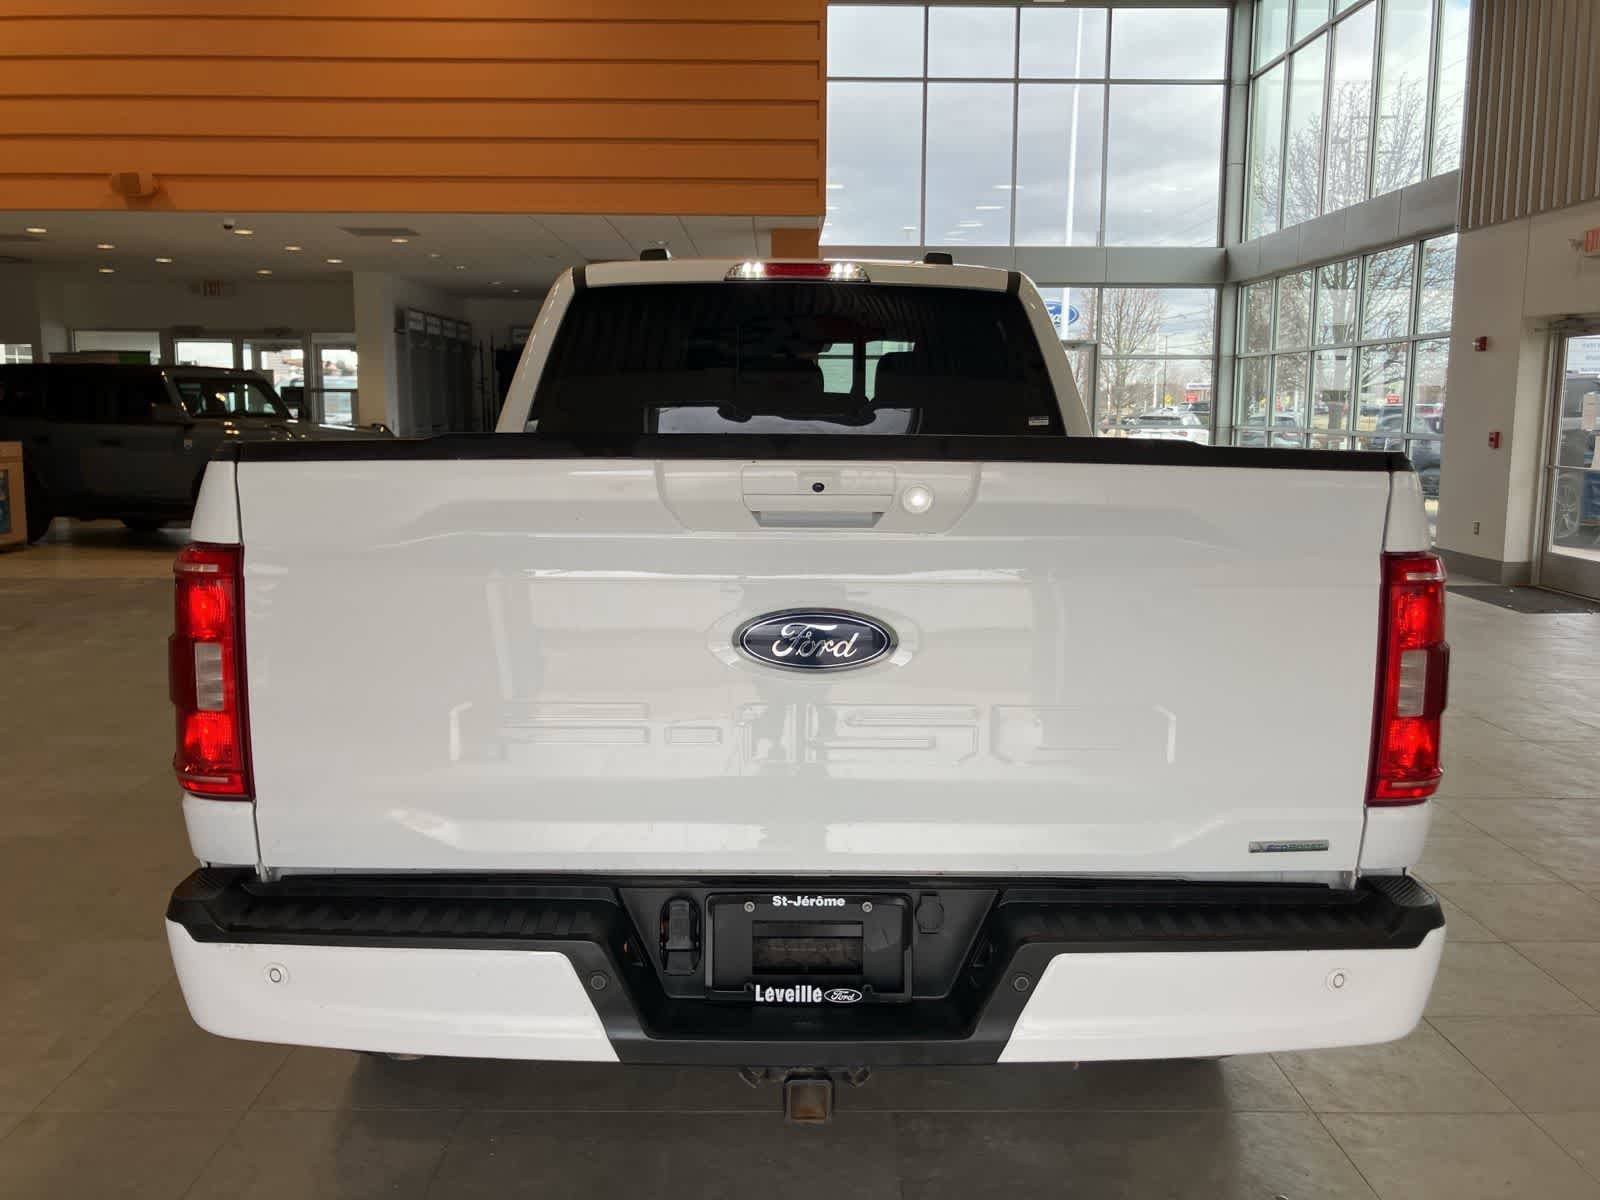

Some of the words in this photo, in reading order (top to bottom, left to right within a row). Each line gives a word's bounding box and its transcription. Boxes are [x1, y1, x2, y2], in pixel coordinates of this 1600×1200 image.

[771, 621, 859, 658] Ford
[772, 895, 846, 907] St-Jérôme
[754, 984, 823, 1003] Léveillé
